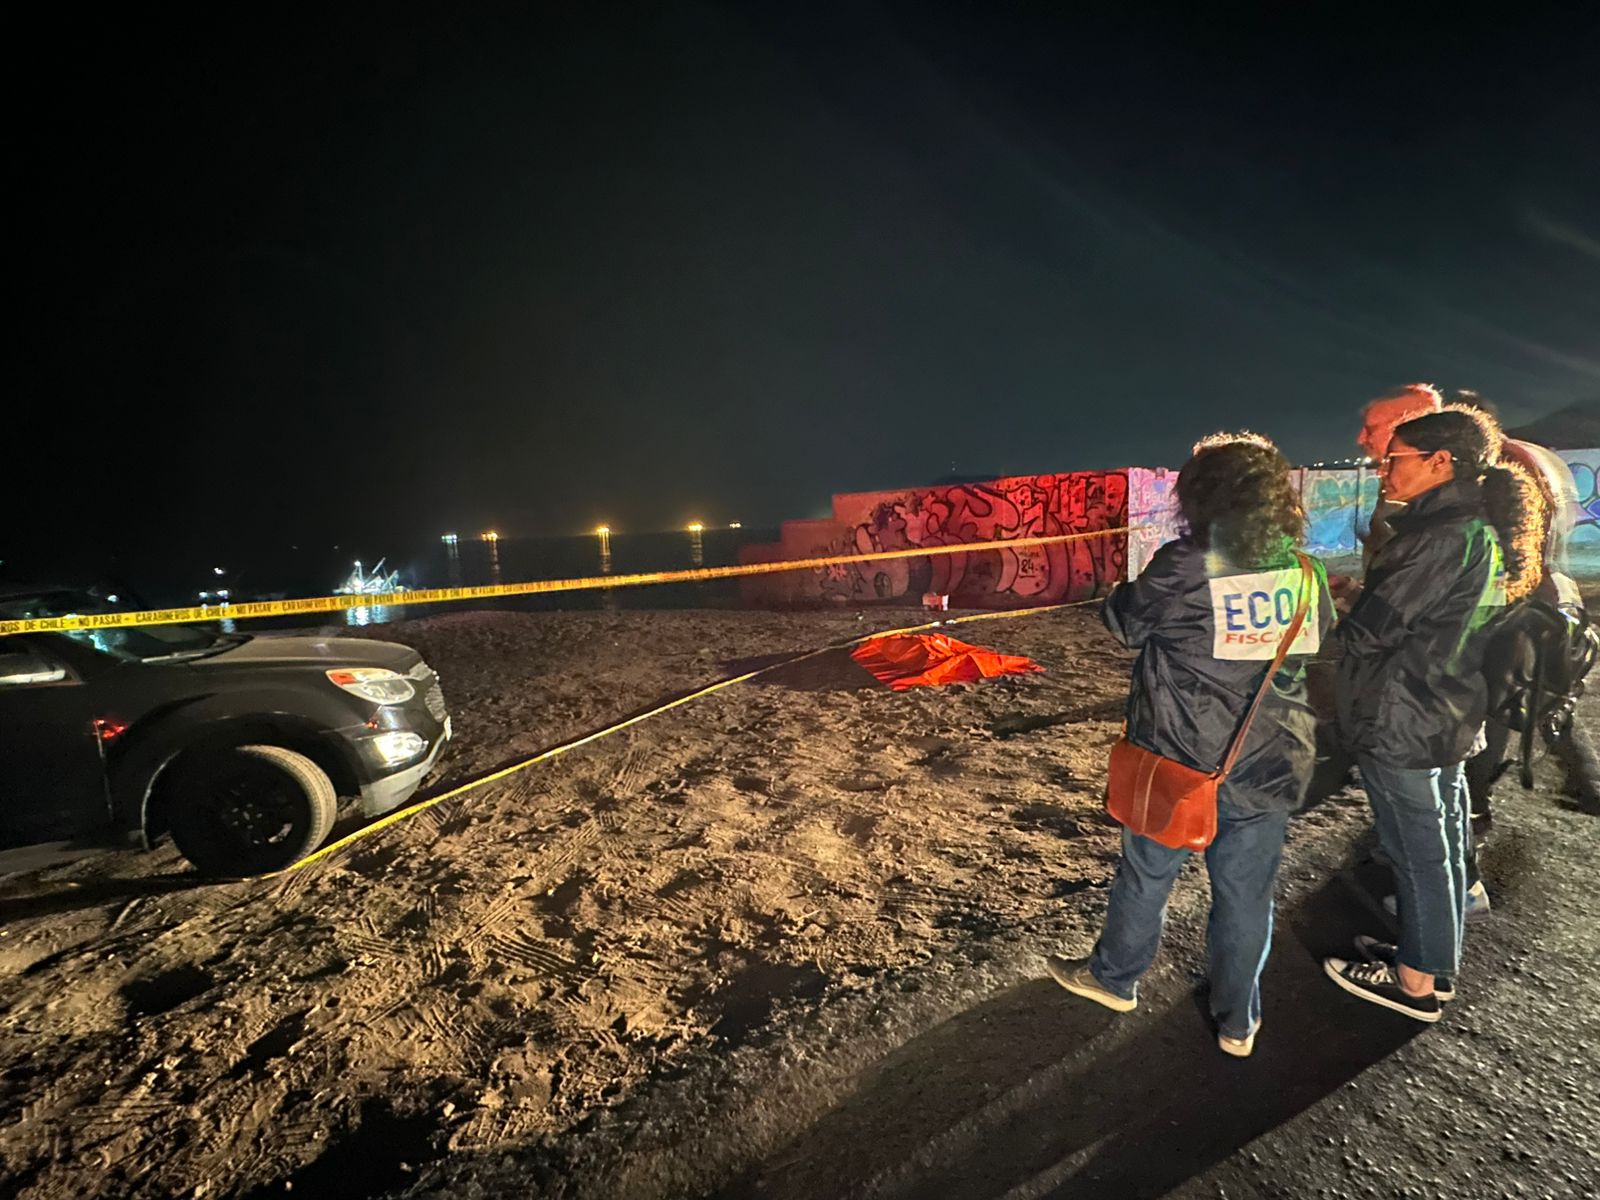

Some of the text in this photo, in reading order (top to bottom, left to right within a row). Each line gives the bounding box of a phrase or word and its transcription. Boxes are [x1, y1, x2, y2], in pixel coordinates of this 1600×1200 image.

[24, 620, 36, 631] DE
[40, 618, 66, 630] CHILE
[78, 616, 90, 627] NO
[92, 614, 122, 626] PASAR
[135, 608, 191, 623] CARABINEROS
